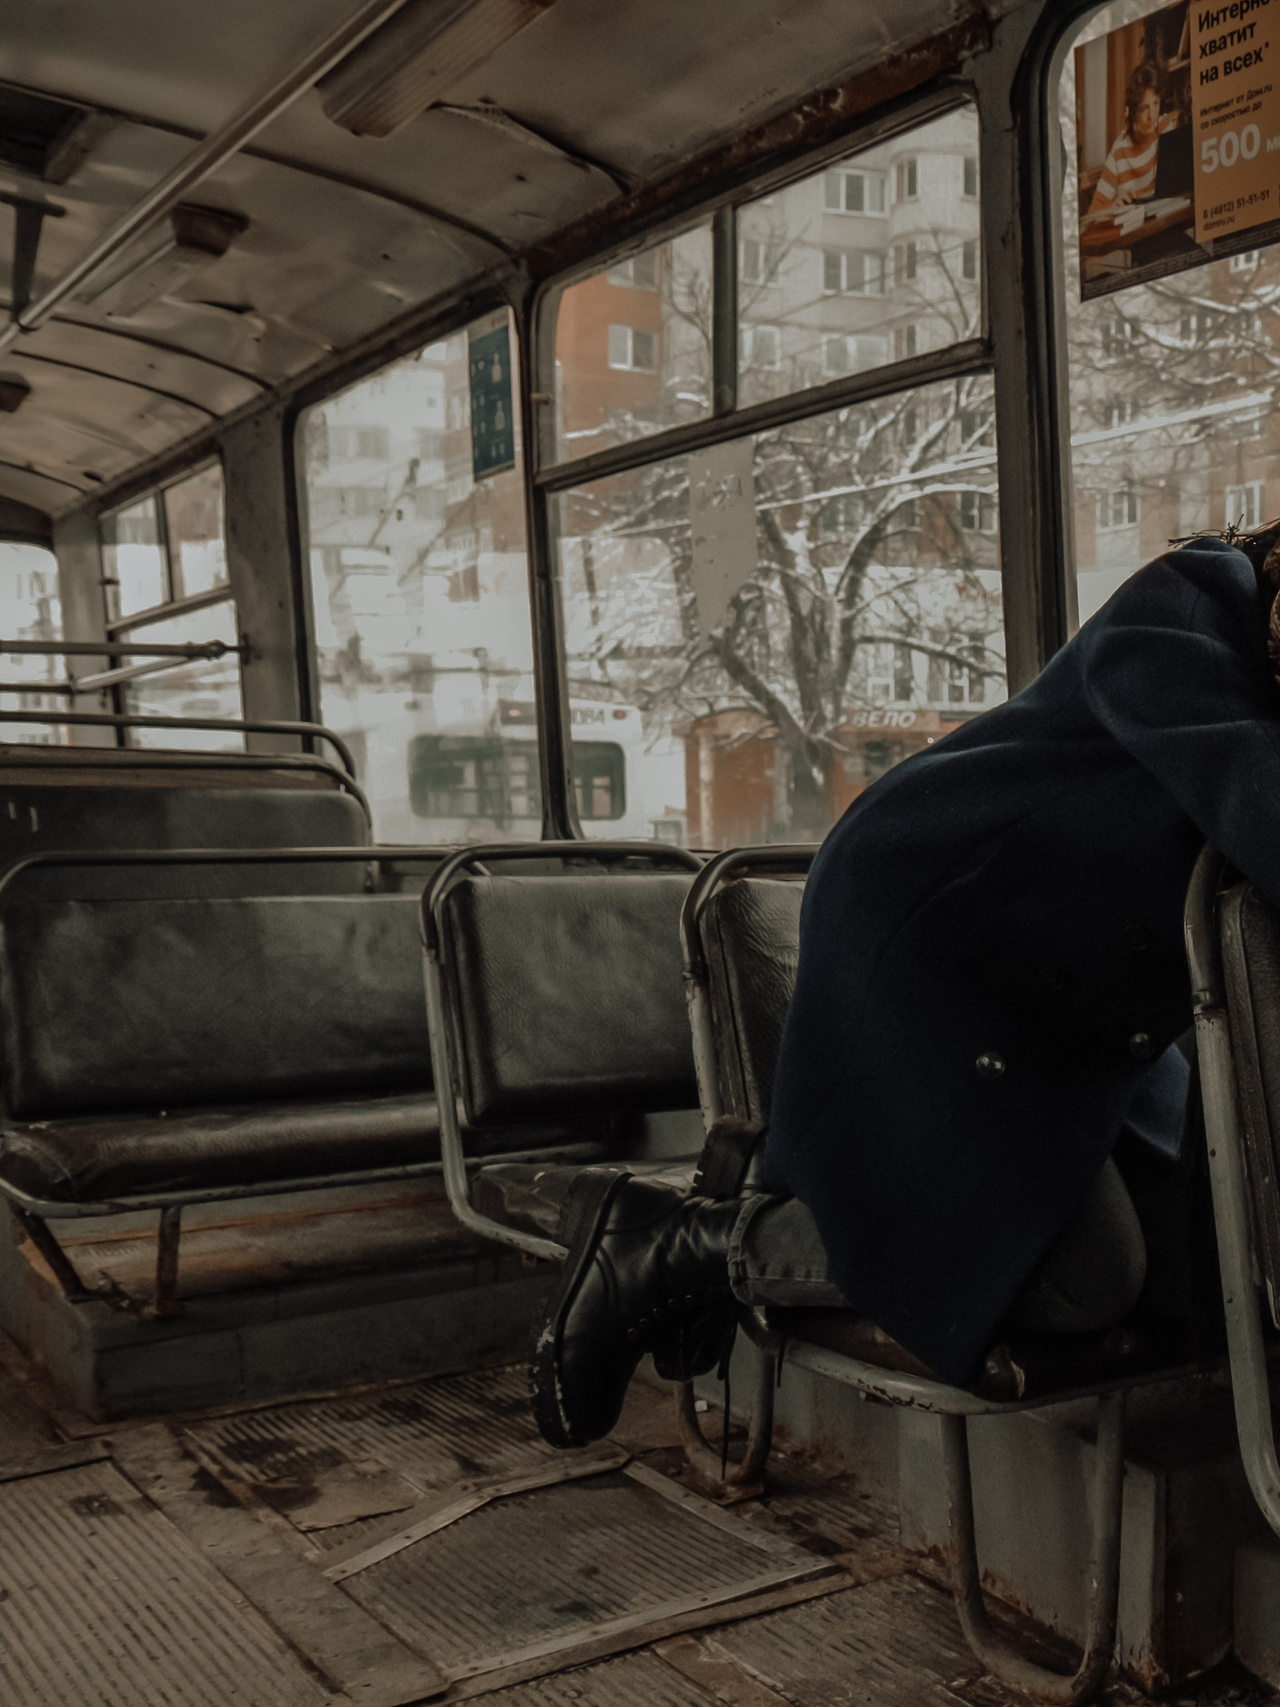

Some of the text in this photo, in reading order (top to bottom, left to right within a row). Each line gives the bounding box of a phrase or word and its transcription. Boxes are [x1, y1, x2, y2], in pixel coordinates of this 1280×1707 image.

[1198, 0, 1275, 33] Интерн
[1199, 22, 1257, 59] хватит
[1200, 65, 1219, 86] на
[1200, 84, 1272, 117] Интернет от Дом.ru
[1200, 101, 1262, 130] со скоростью до
[1201, 123, 1261, 174] 500
[1210, 202, 1234, 218] (4912)
[1237, 190, 1270, 209] 51-51-51
[1203, 215, 1235, 231] domru.ru
